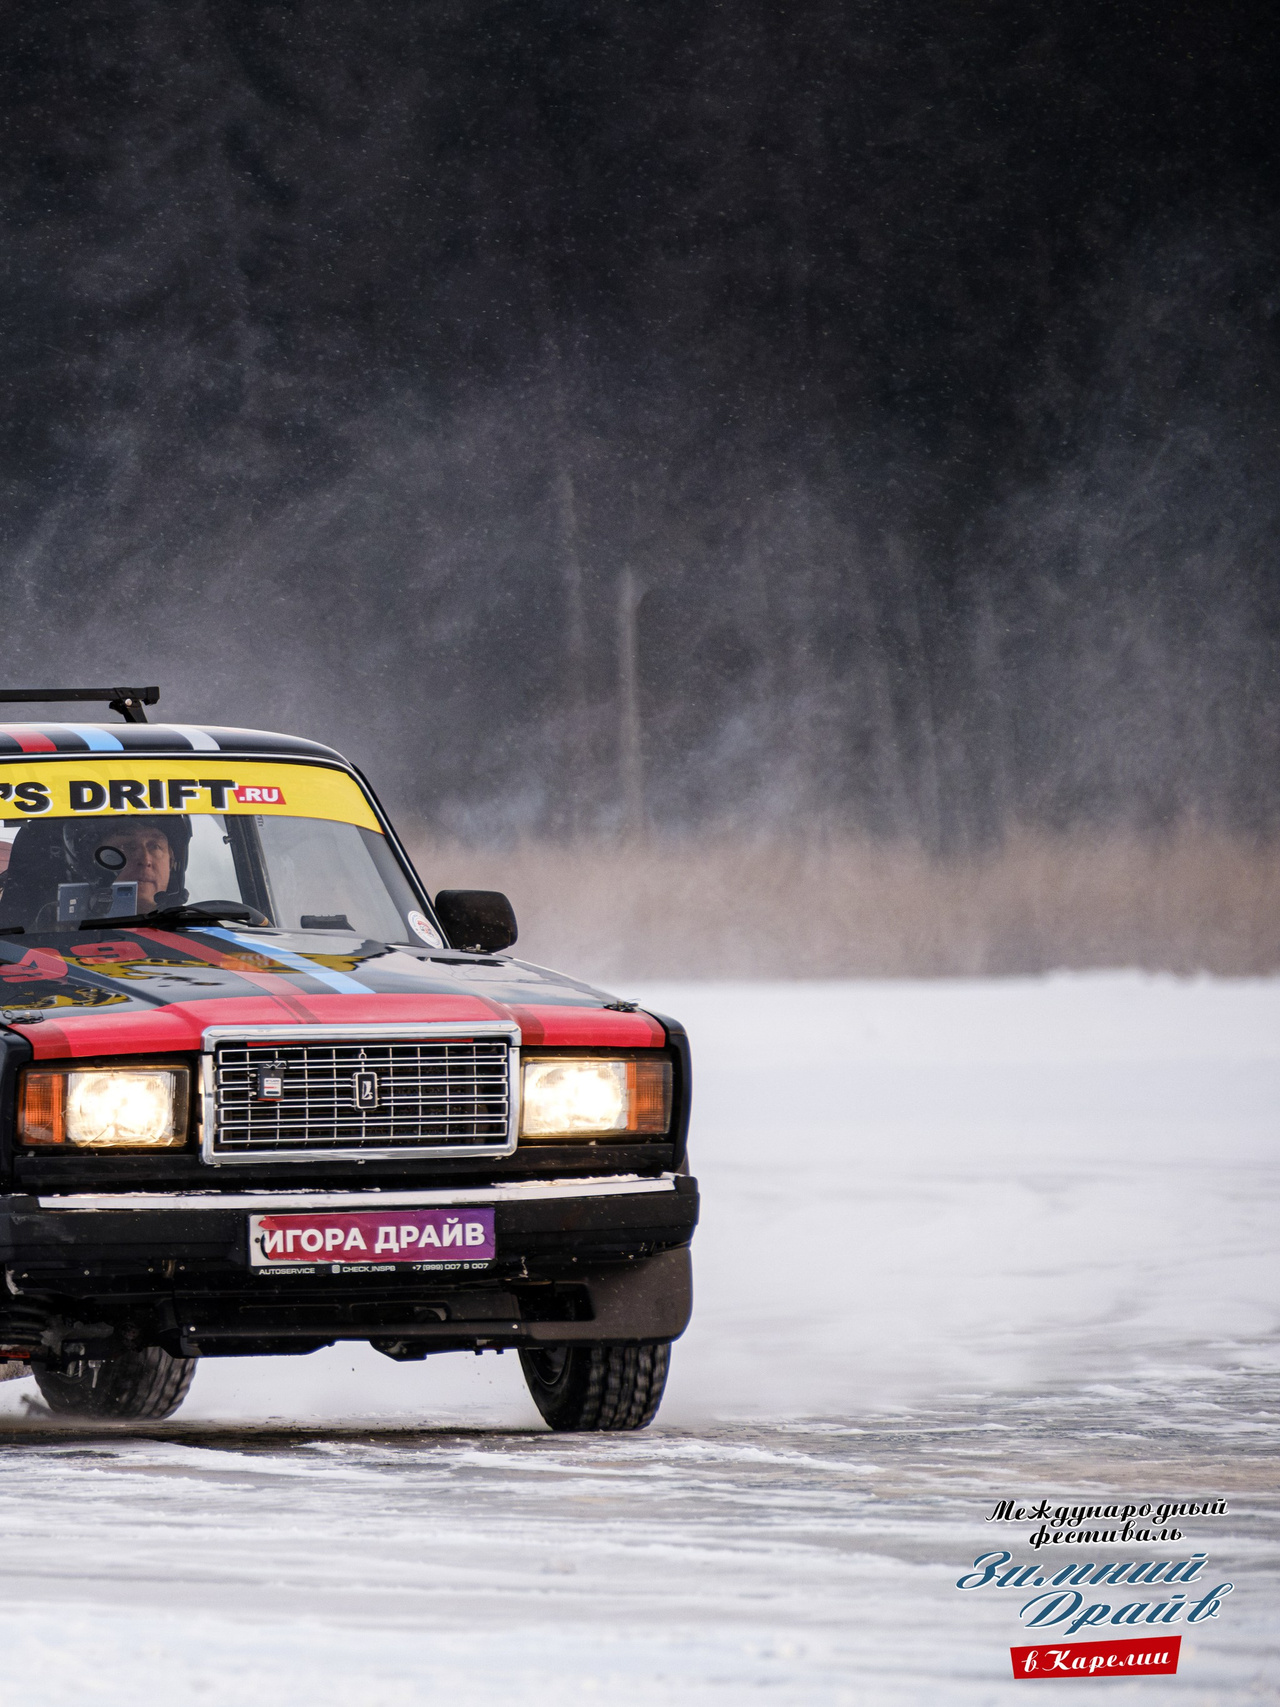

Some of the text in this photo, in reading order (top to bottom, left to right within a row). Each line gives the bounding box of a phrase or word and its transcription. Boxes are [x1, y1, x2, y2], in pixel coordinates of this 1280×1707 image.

[69, 778, 239, 811] DRIFT
[264, 1217, 486, 1254] ИГОРА ДРАЙВ
[259, 1267, 315, 1275] AUTOSERVICE
